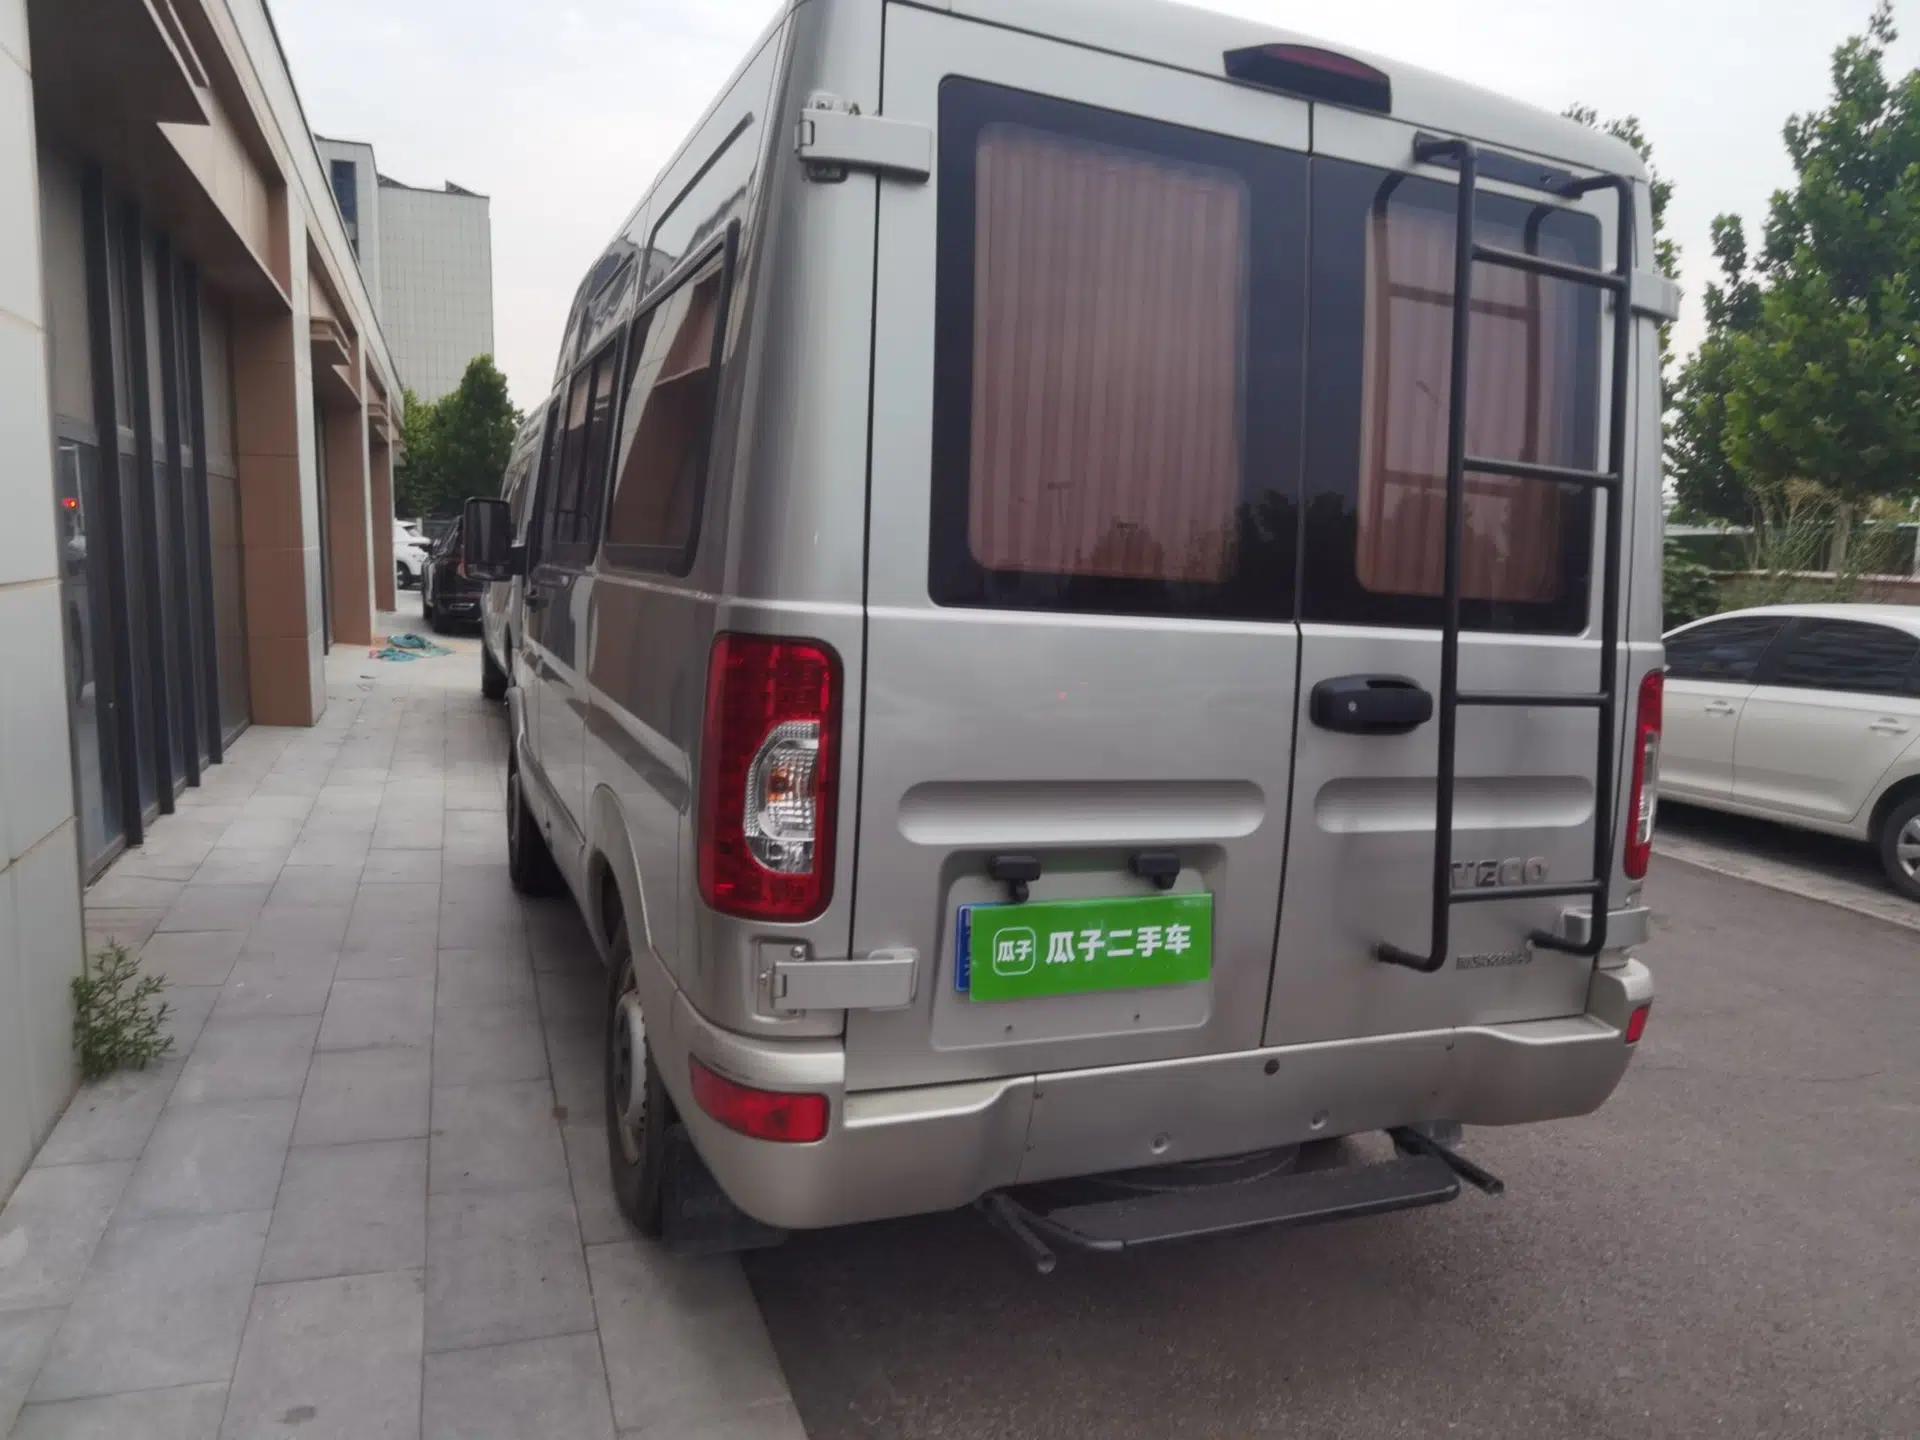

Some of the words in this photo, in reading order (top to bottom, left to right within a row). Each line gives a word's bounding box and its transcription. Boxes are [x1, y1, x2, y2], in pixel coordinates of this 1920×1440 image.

[1450, 857, 1550, 888] VECO
[996, 938, 1033, 963] 瓜子
[1045, 923, 1192, 965] 瓜子二手车
